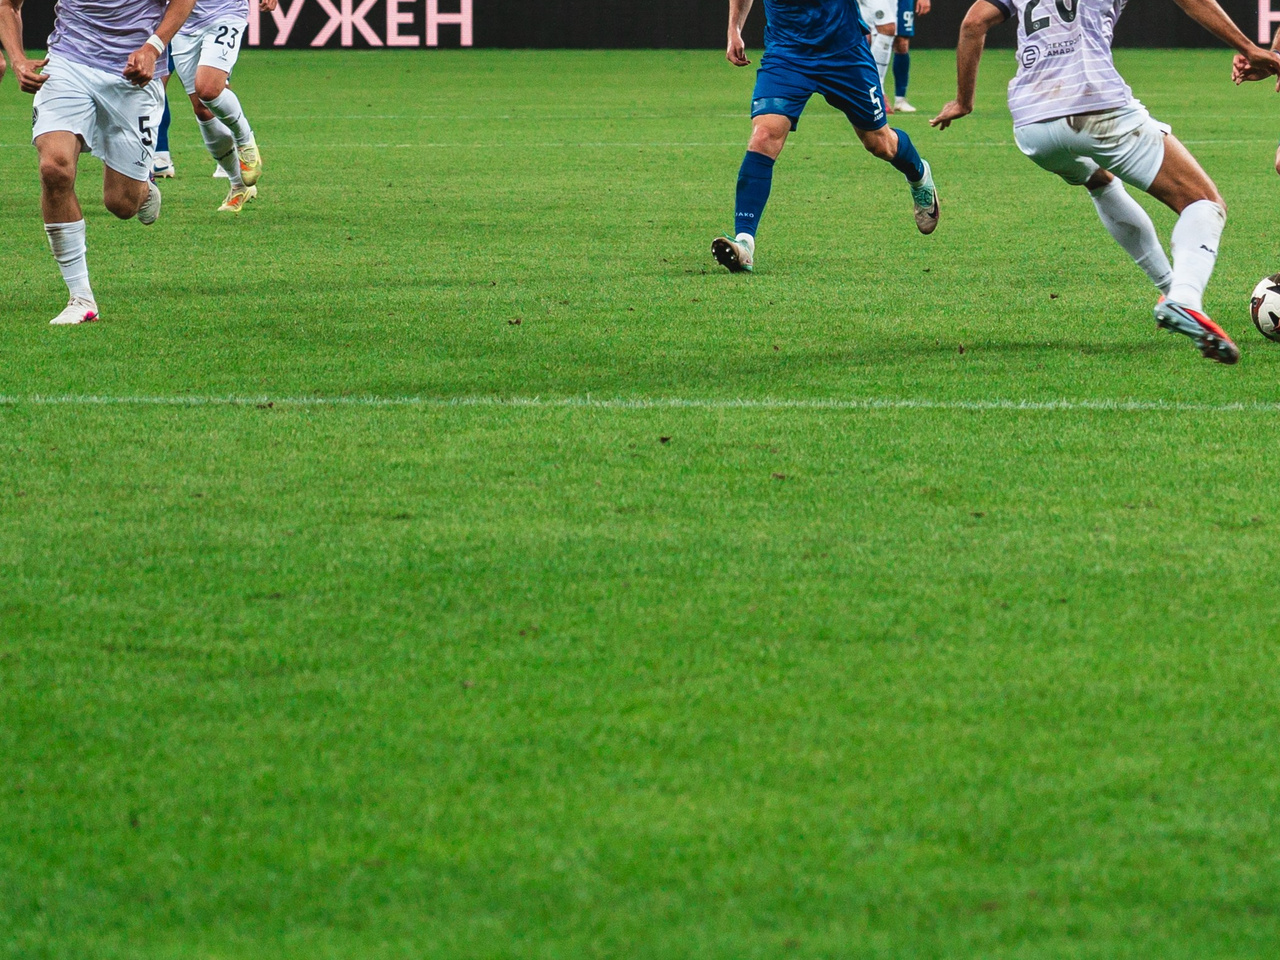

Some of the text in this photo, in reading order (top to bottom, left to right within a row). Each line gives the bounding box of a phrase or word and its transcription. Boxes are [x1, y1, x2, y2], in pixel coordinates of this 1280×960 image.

[214, 25, 239, 49] 23
[1043, 47, 1075, 58] АМАРА
[869, 85, 883, 116] 5
[138, 116, 152, 146] 5
[735, 211, 755, 219] JAKO
